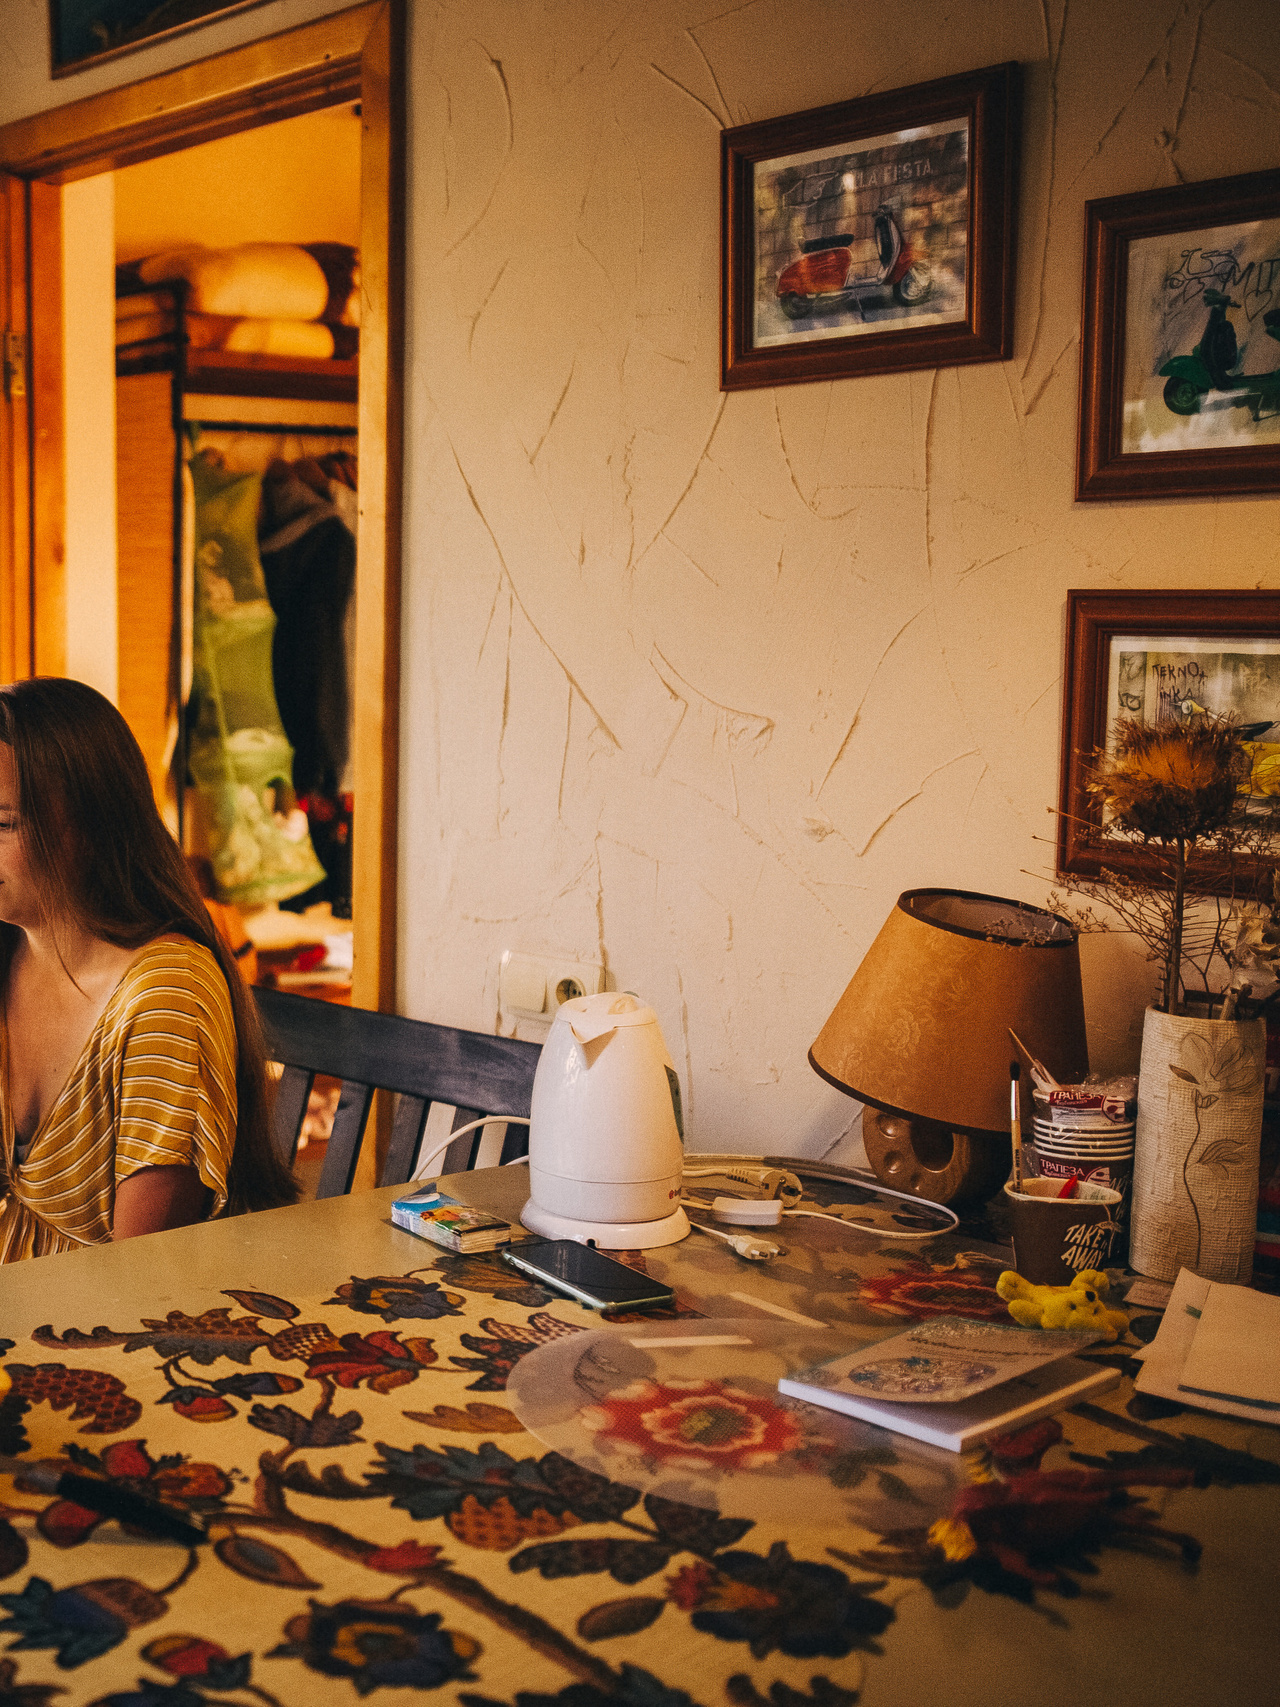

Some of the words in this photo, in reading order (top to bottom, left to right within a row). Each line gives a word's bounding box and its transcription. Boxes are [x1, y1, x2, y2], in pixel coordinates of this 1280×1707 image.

[1040, 1158, 1086, 1177] ТРАПЕЗА
[1064, 1224, 1105, 1248] TAKE
[1060, 1245, 1105, 1271] AWAY
